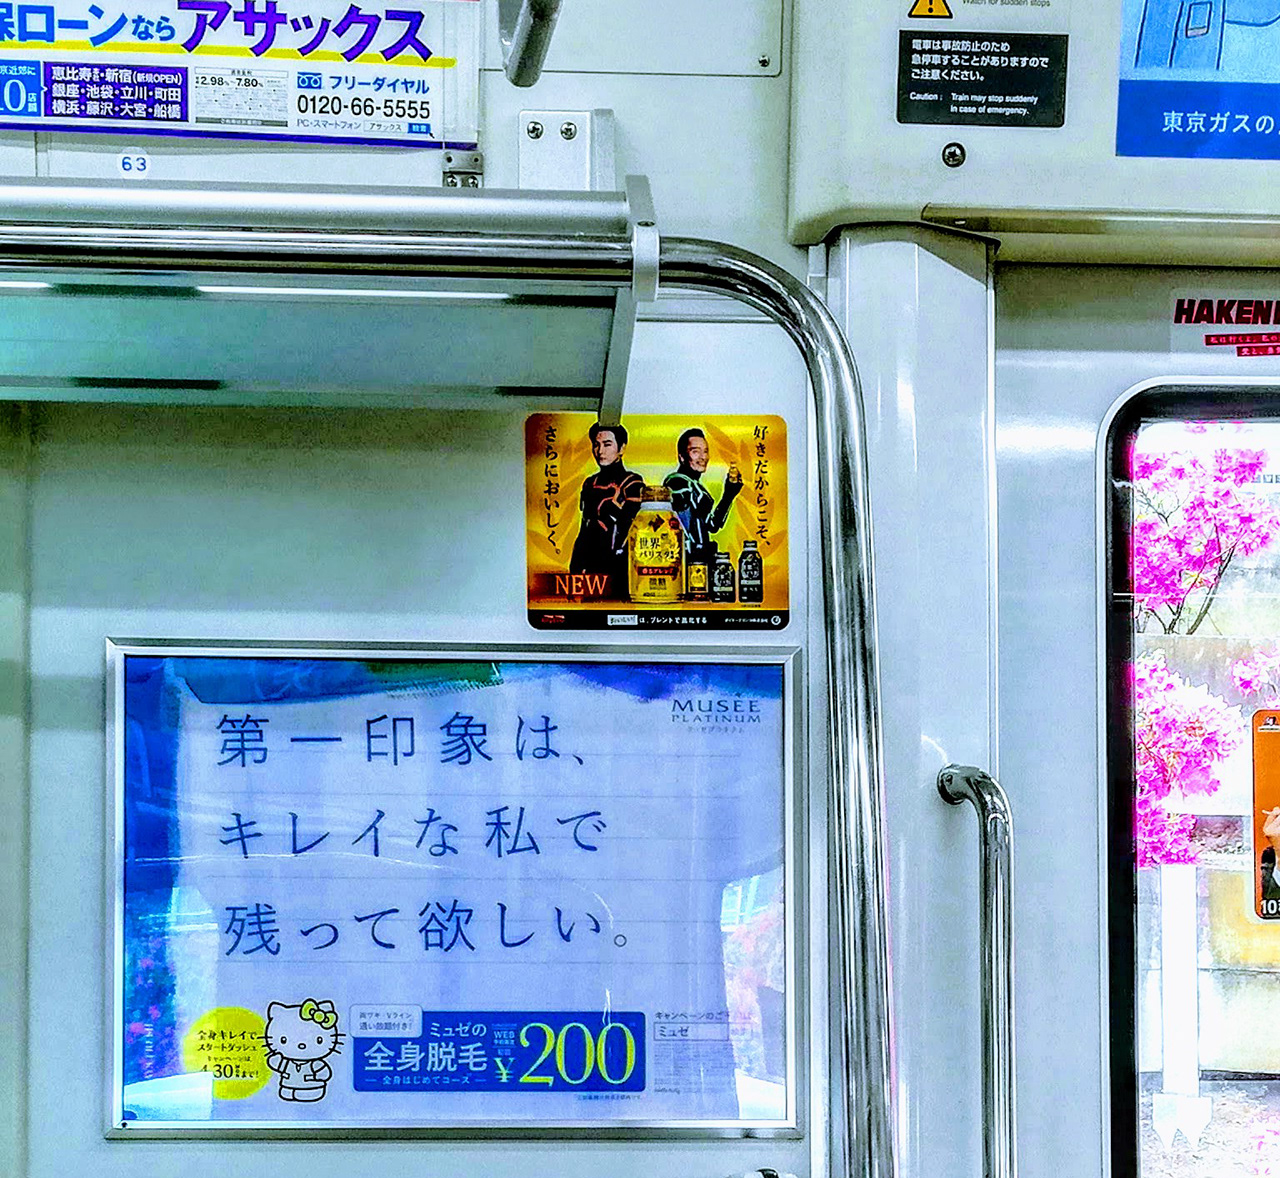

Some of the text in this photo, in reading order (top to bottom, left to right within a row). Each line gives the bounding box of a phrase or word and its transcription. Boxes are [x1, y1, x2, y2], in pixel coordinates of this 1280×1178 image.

[911, 39, 1010, 52] 電車は事故防止のため
[911, 53, 1049, 68] 急停車することがありますので
[911, 69, 985, 81] ご注意ください。
[329, 75, 430, 95] フリーダイヤル
[951, 92, 969, 101] Train
[971, 94, 986, 103] may
[988, 95, 1004, 103] stop
[1005, 95, 1038, 105] suddenly
[297, 94, 431, 119] 0120-66-5555
[978, 105, 986, 114] of
[987, 107, 1030, 116] emergency.
[121, 156, 147, 171] 63
[542, 424, 562, 555] さらにおいしく。
[752, 424, 772, 547] 好きだからこそ、
[554, 573, 609, 595] NEW
[671, 714, 762, 723] PLATINUM
[216, 711, 586, 768] 第一印象は、
[217, 805, 610, 860] キレイな私で
[222, 900, 629, 957] 残って欲しい。
[197, 1030, 258, 1041] 全身キレイで
[430, 1022, 487, 1038] ミュゼの
[493, 1031, 515, 1039] WEB
[658, 1026, 690, 1038] ミュゼ
[364, 1041, 488, 1073] 全身脱毛
